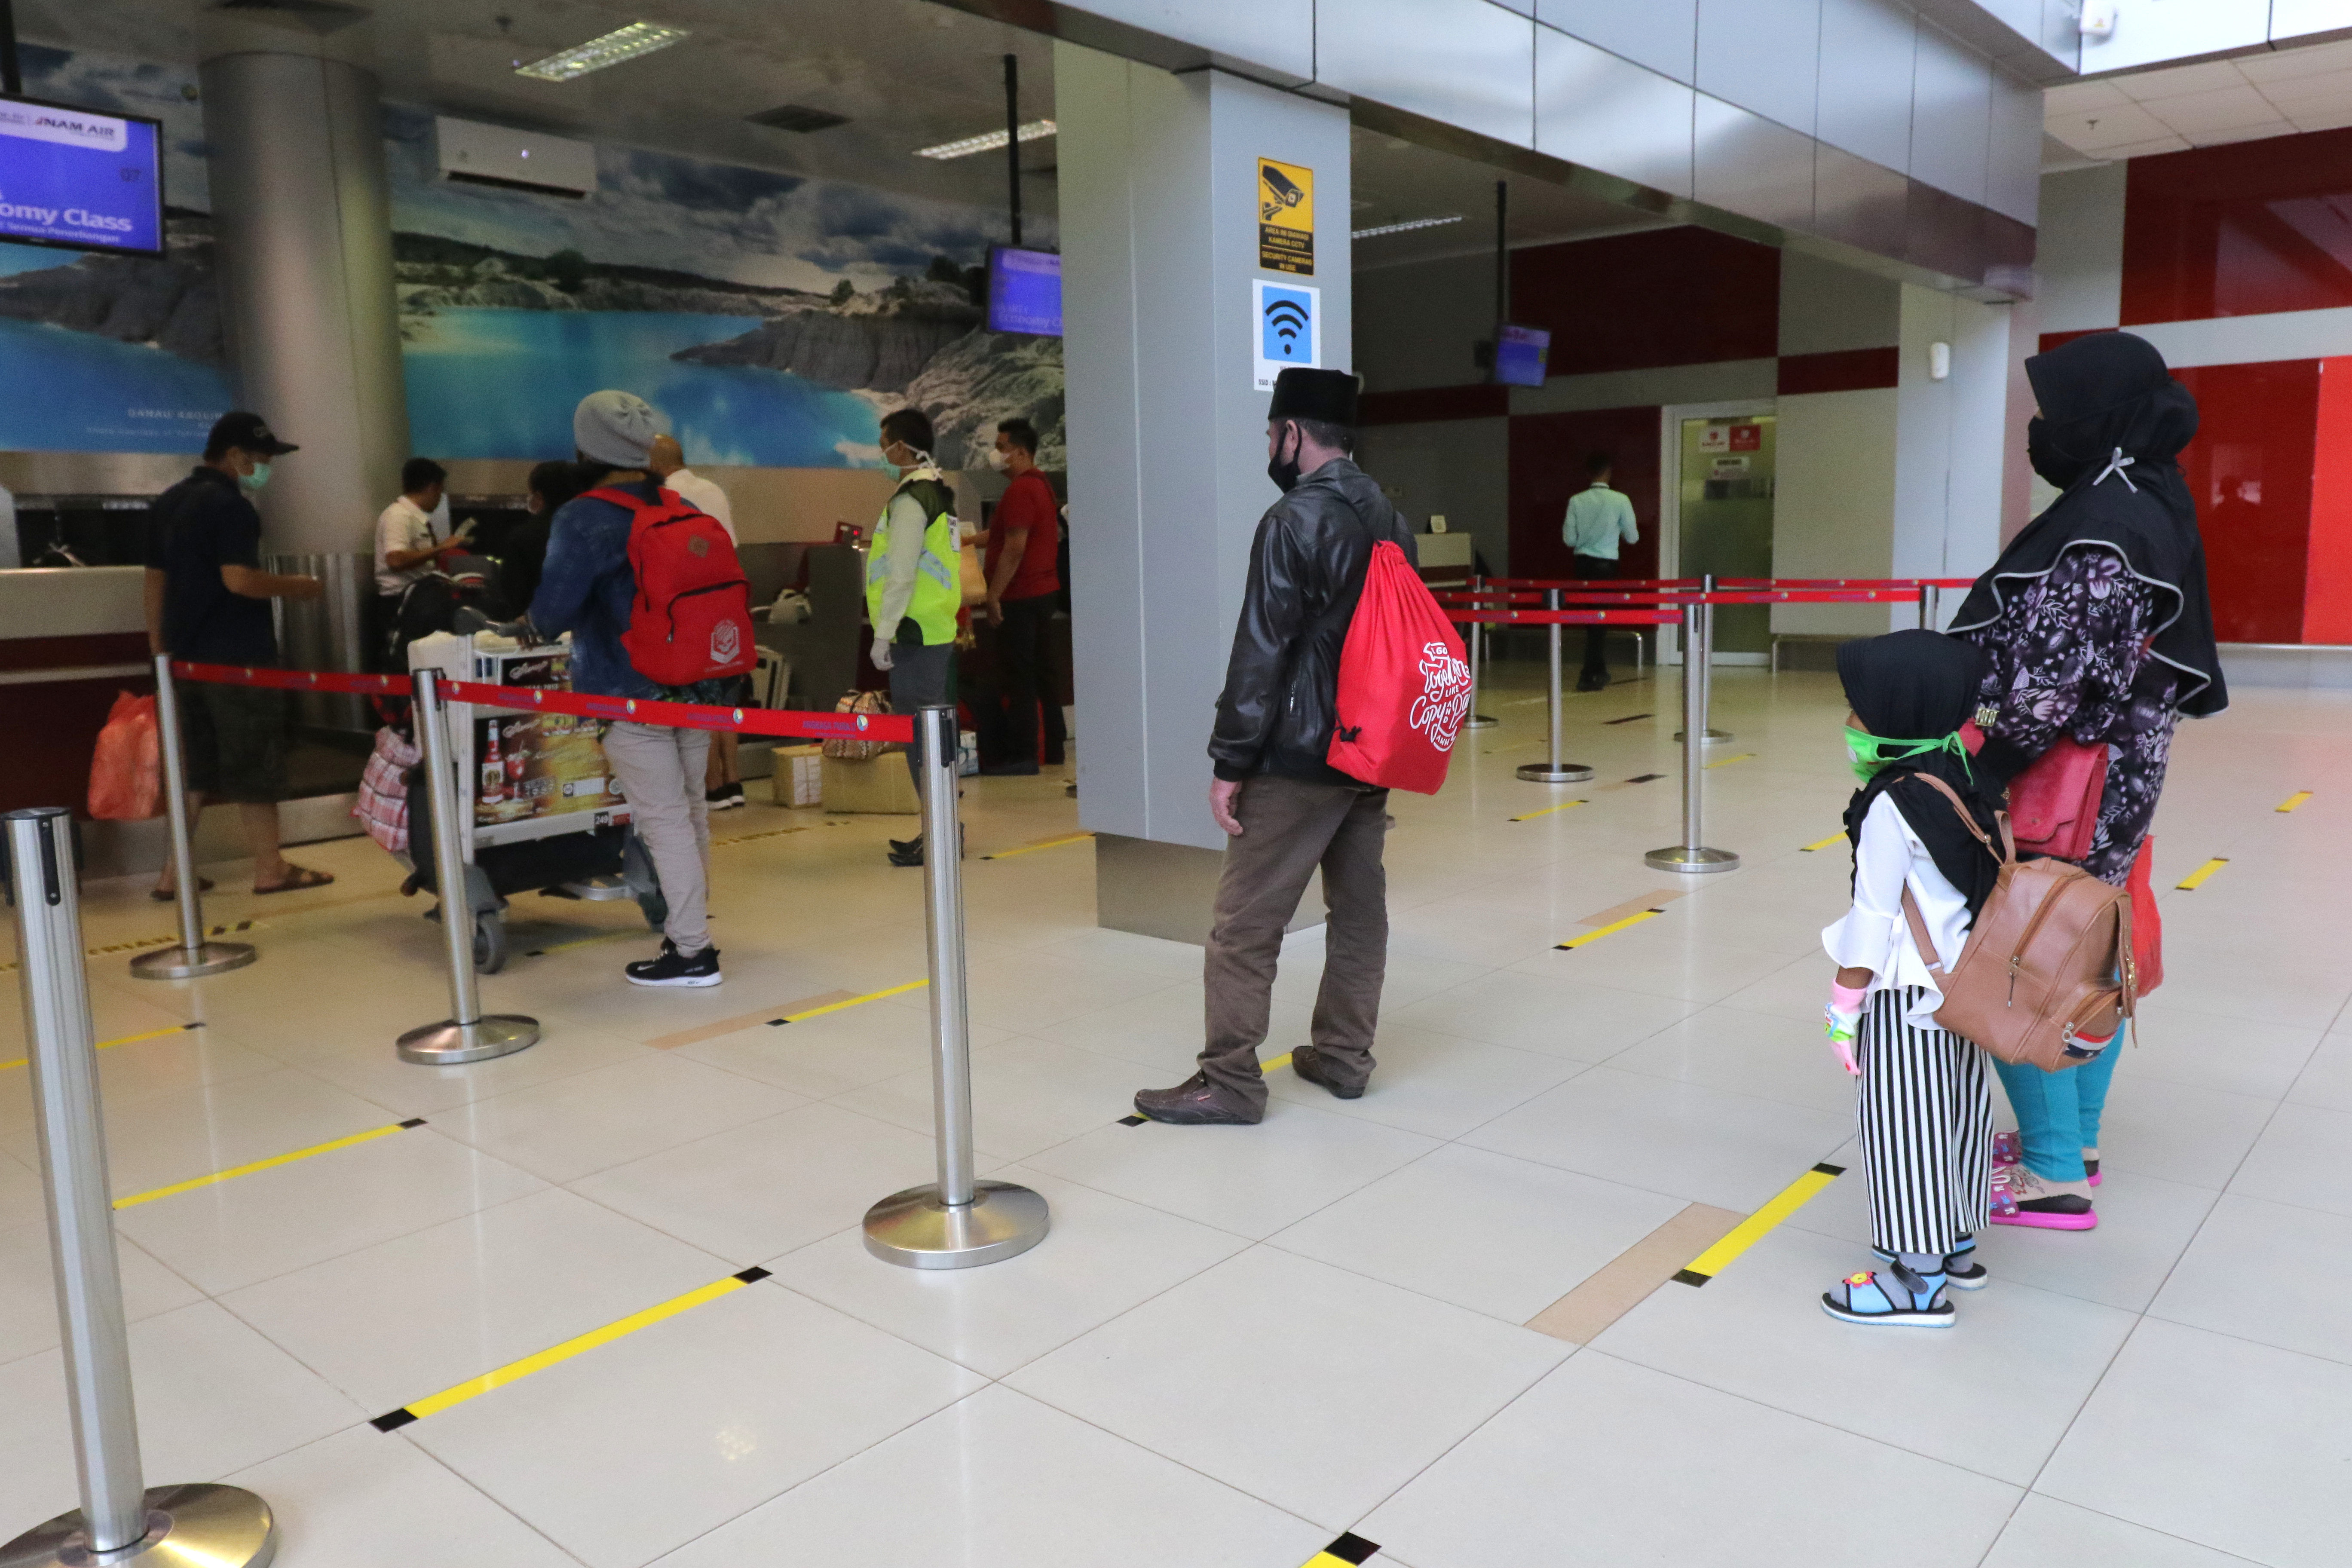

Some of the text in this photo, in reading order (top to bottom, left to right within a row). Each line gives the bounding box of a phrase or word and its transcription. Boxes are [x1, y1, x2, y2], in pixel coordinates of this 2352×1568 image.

[46, 118, 115, 136] NAM AIR
[64, 208, 133, 232] Class
[1268, 236, 1305, 249] KAMERA CCTV
[1262, 251, 1313, 266] SECURITY CAMERAS
[1285, 263, 1296, 272] USE
[1445, 684, 1460, 698] LIKE
[1409, 695, 1447, 743] Copy
